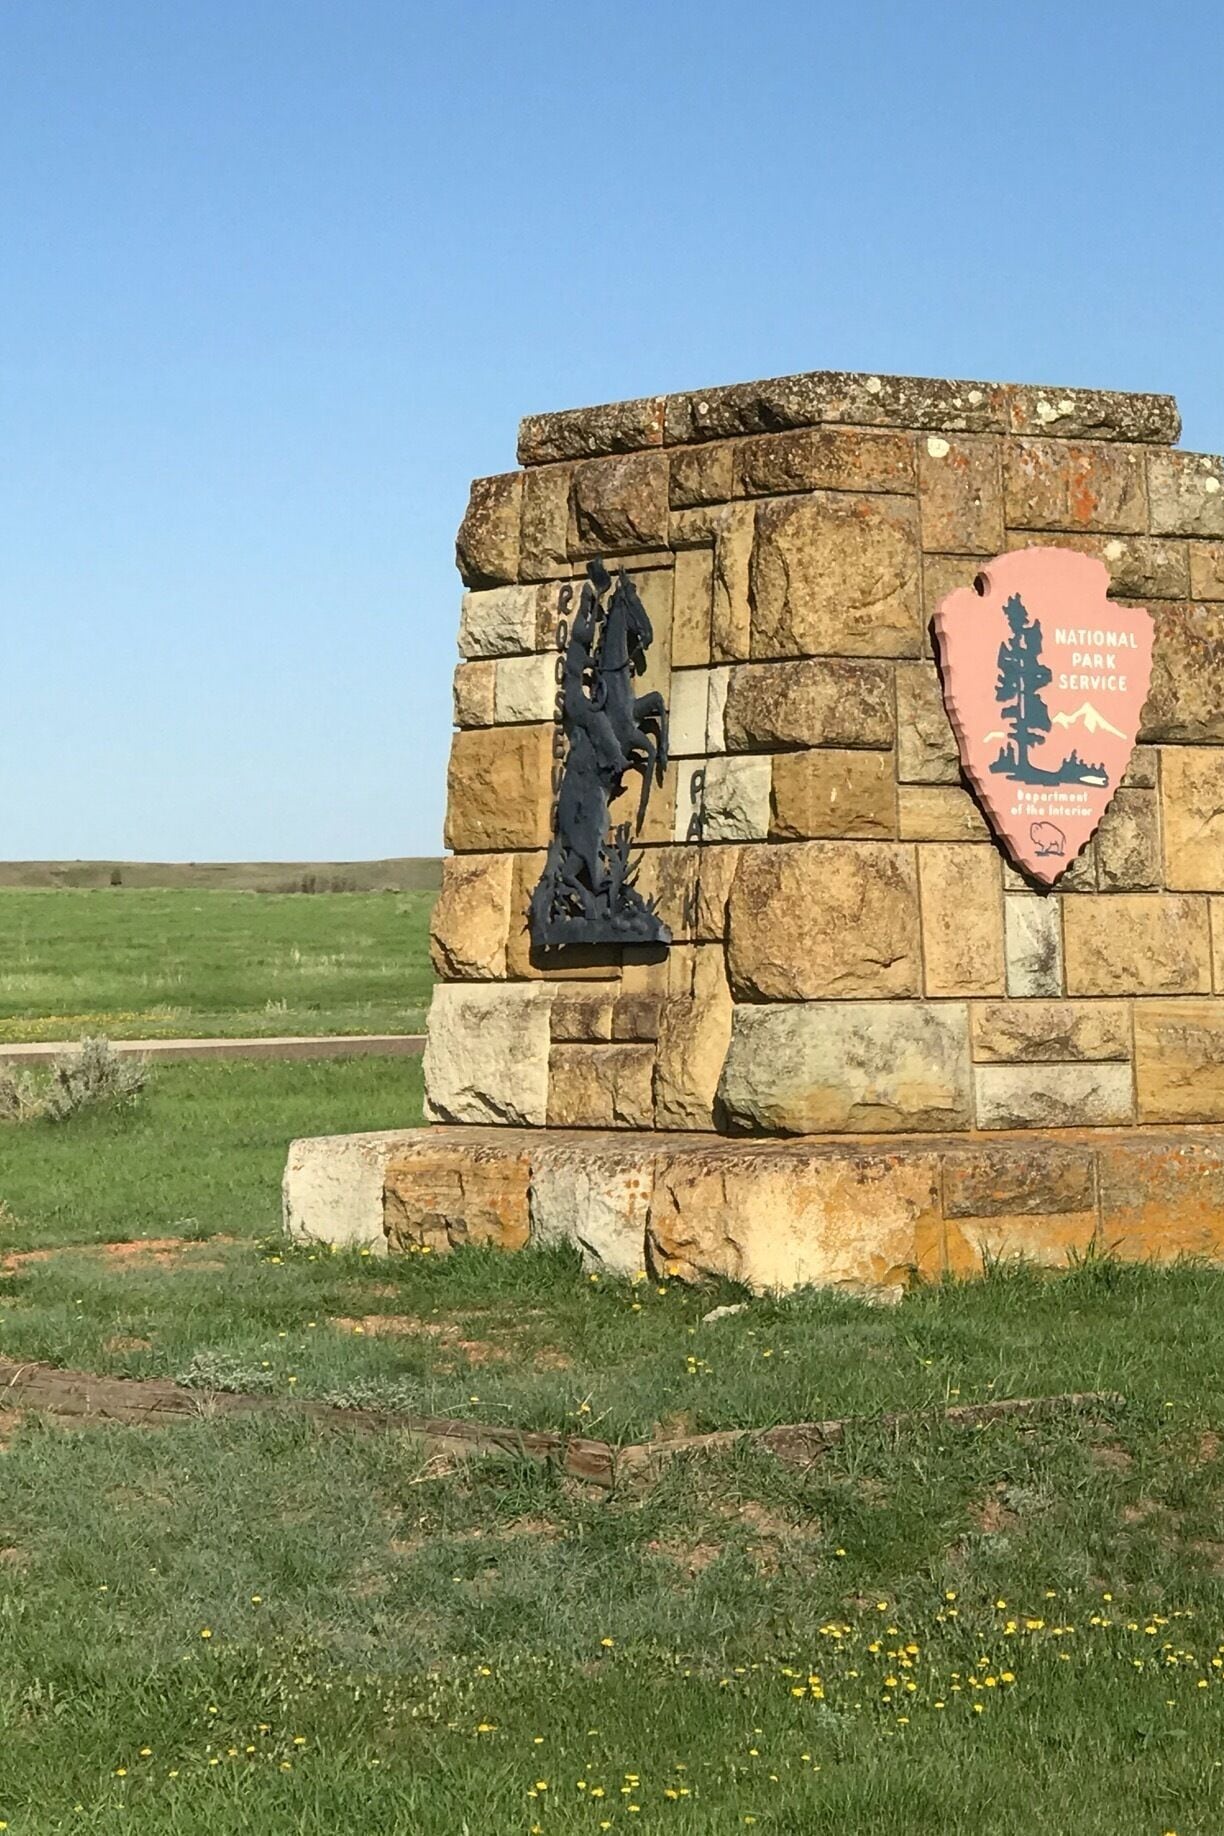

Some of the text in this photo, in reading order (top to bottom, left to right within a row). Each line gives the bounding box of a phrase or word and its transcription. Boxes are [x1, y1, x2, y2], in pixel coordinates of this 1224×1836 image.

[1055, 628, 1138, 649] NATIONAL
[1072, 652, 1116, 669] PARK
[1059, 674, 1127, 692] SERVICE
[1017, 789, 1088, 803] Department
[1011, 804, 1092, 816] of the Interior
